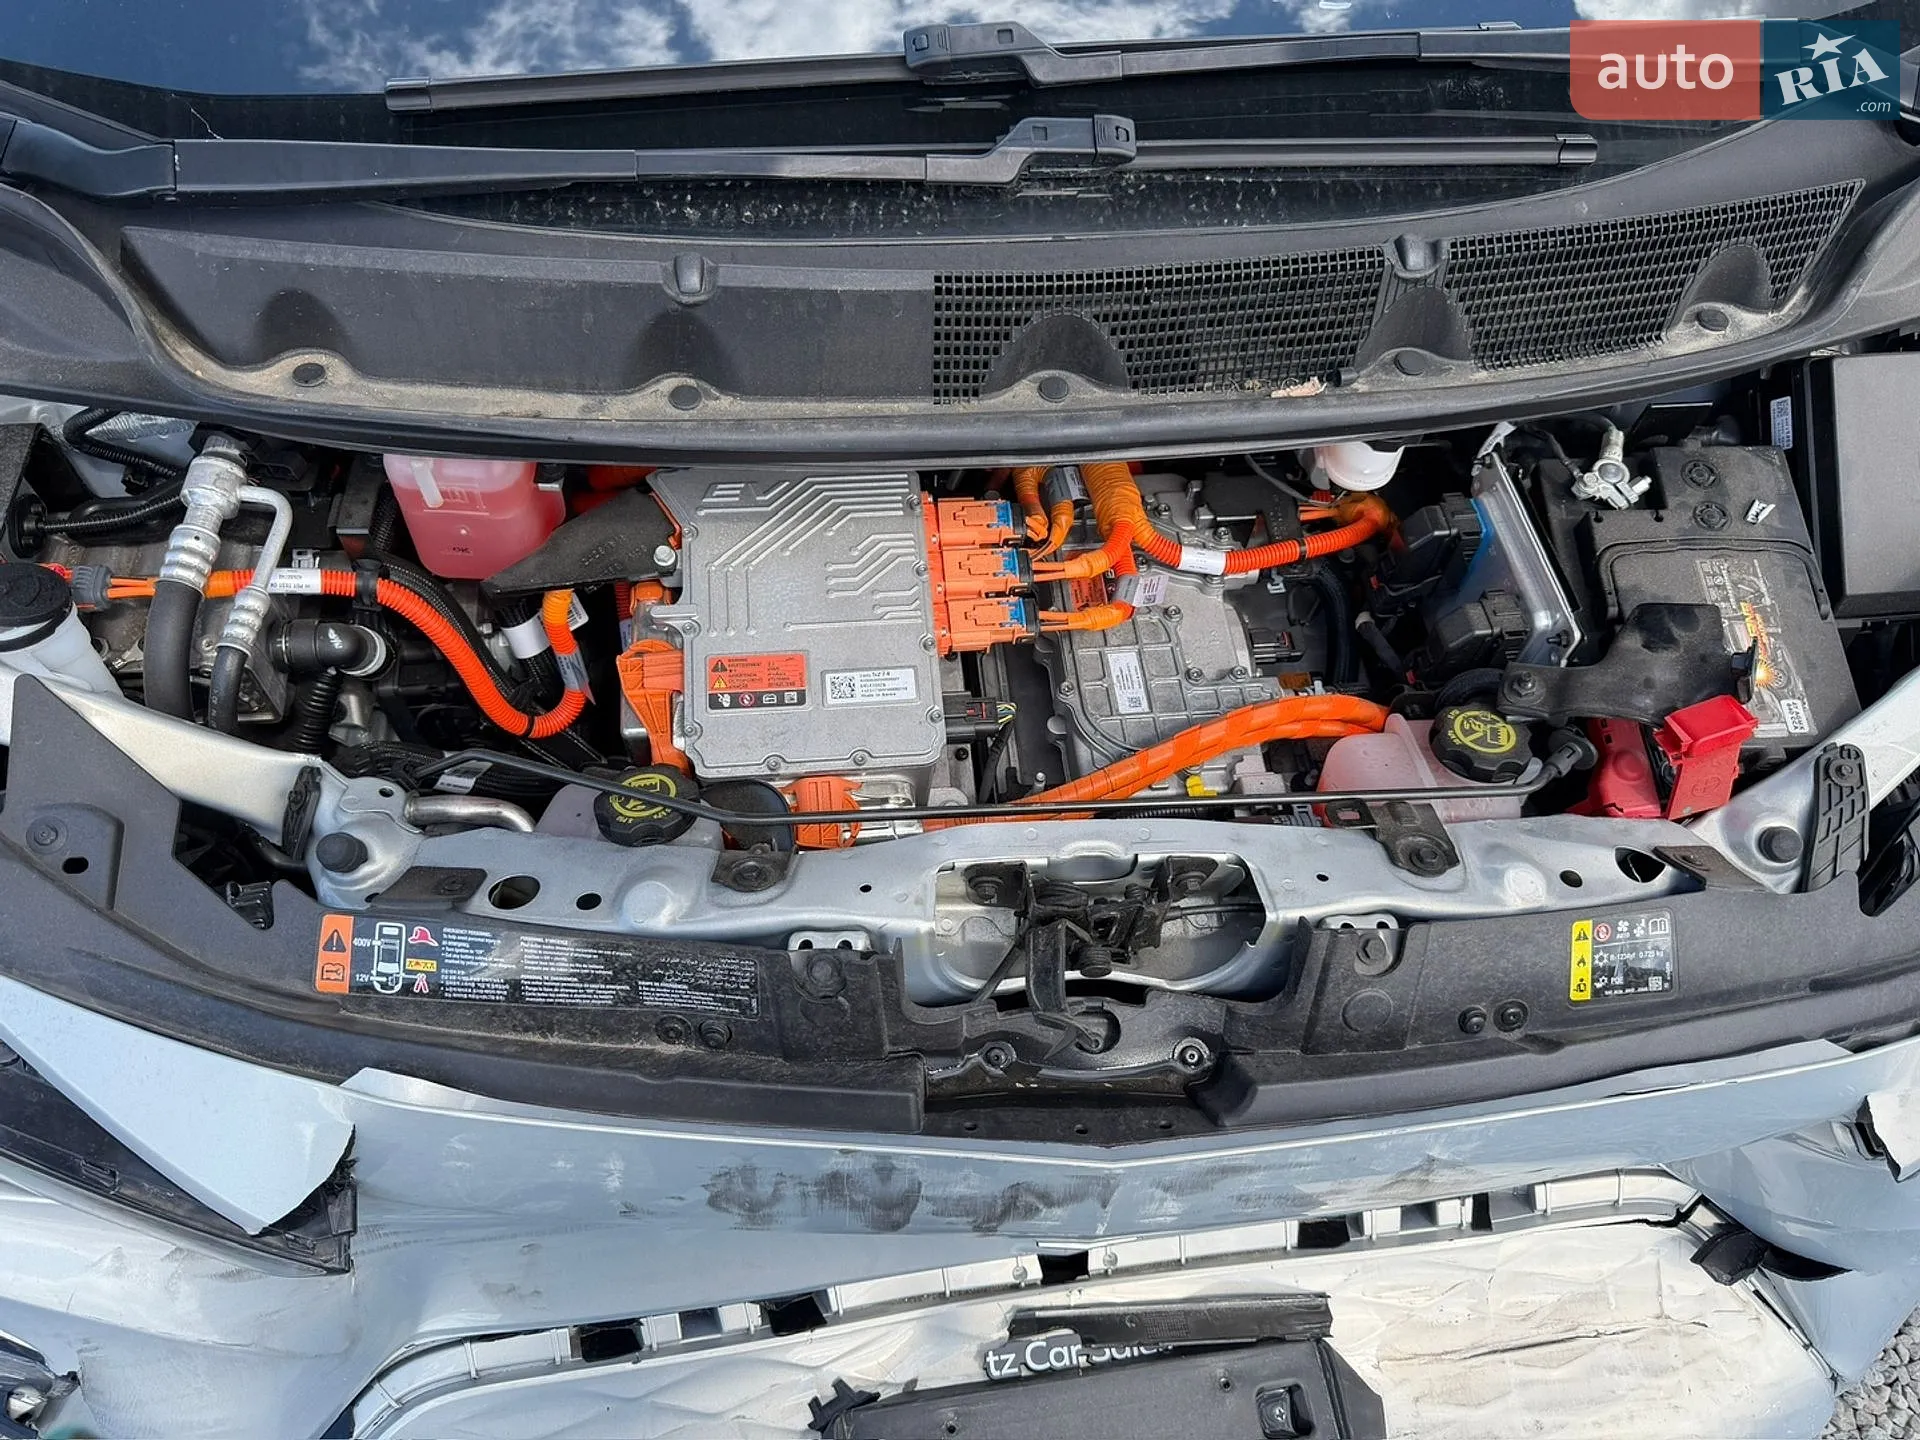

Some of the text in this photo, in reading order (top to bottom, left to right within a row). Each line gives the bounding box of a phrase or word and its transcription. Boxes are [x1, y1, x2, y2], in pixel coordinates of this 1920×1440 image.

[702, 481, 790, 502] EV
[352, 938, 370, 947] 400V
[356, 974, 370, 982] 12V
[1025, 1341, 1082, 1371] Car
